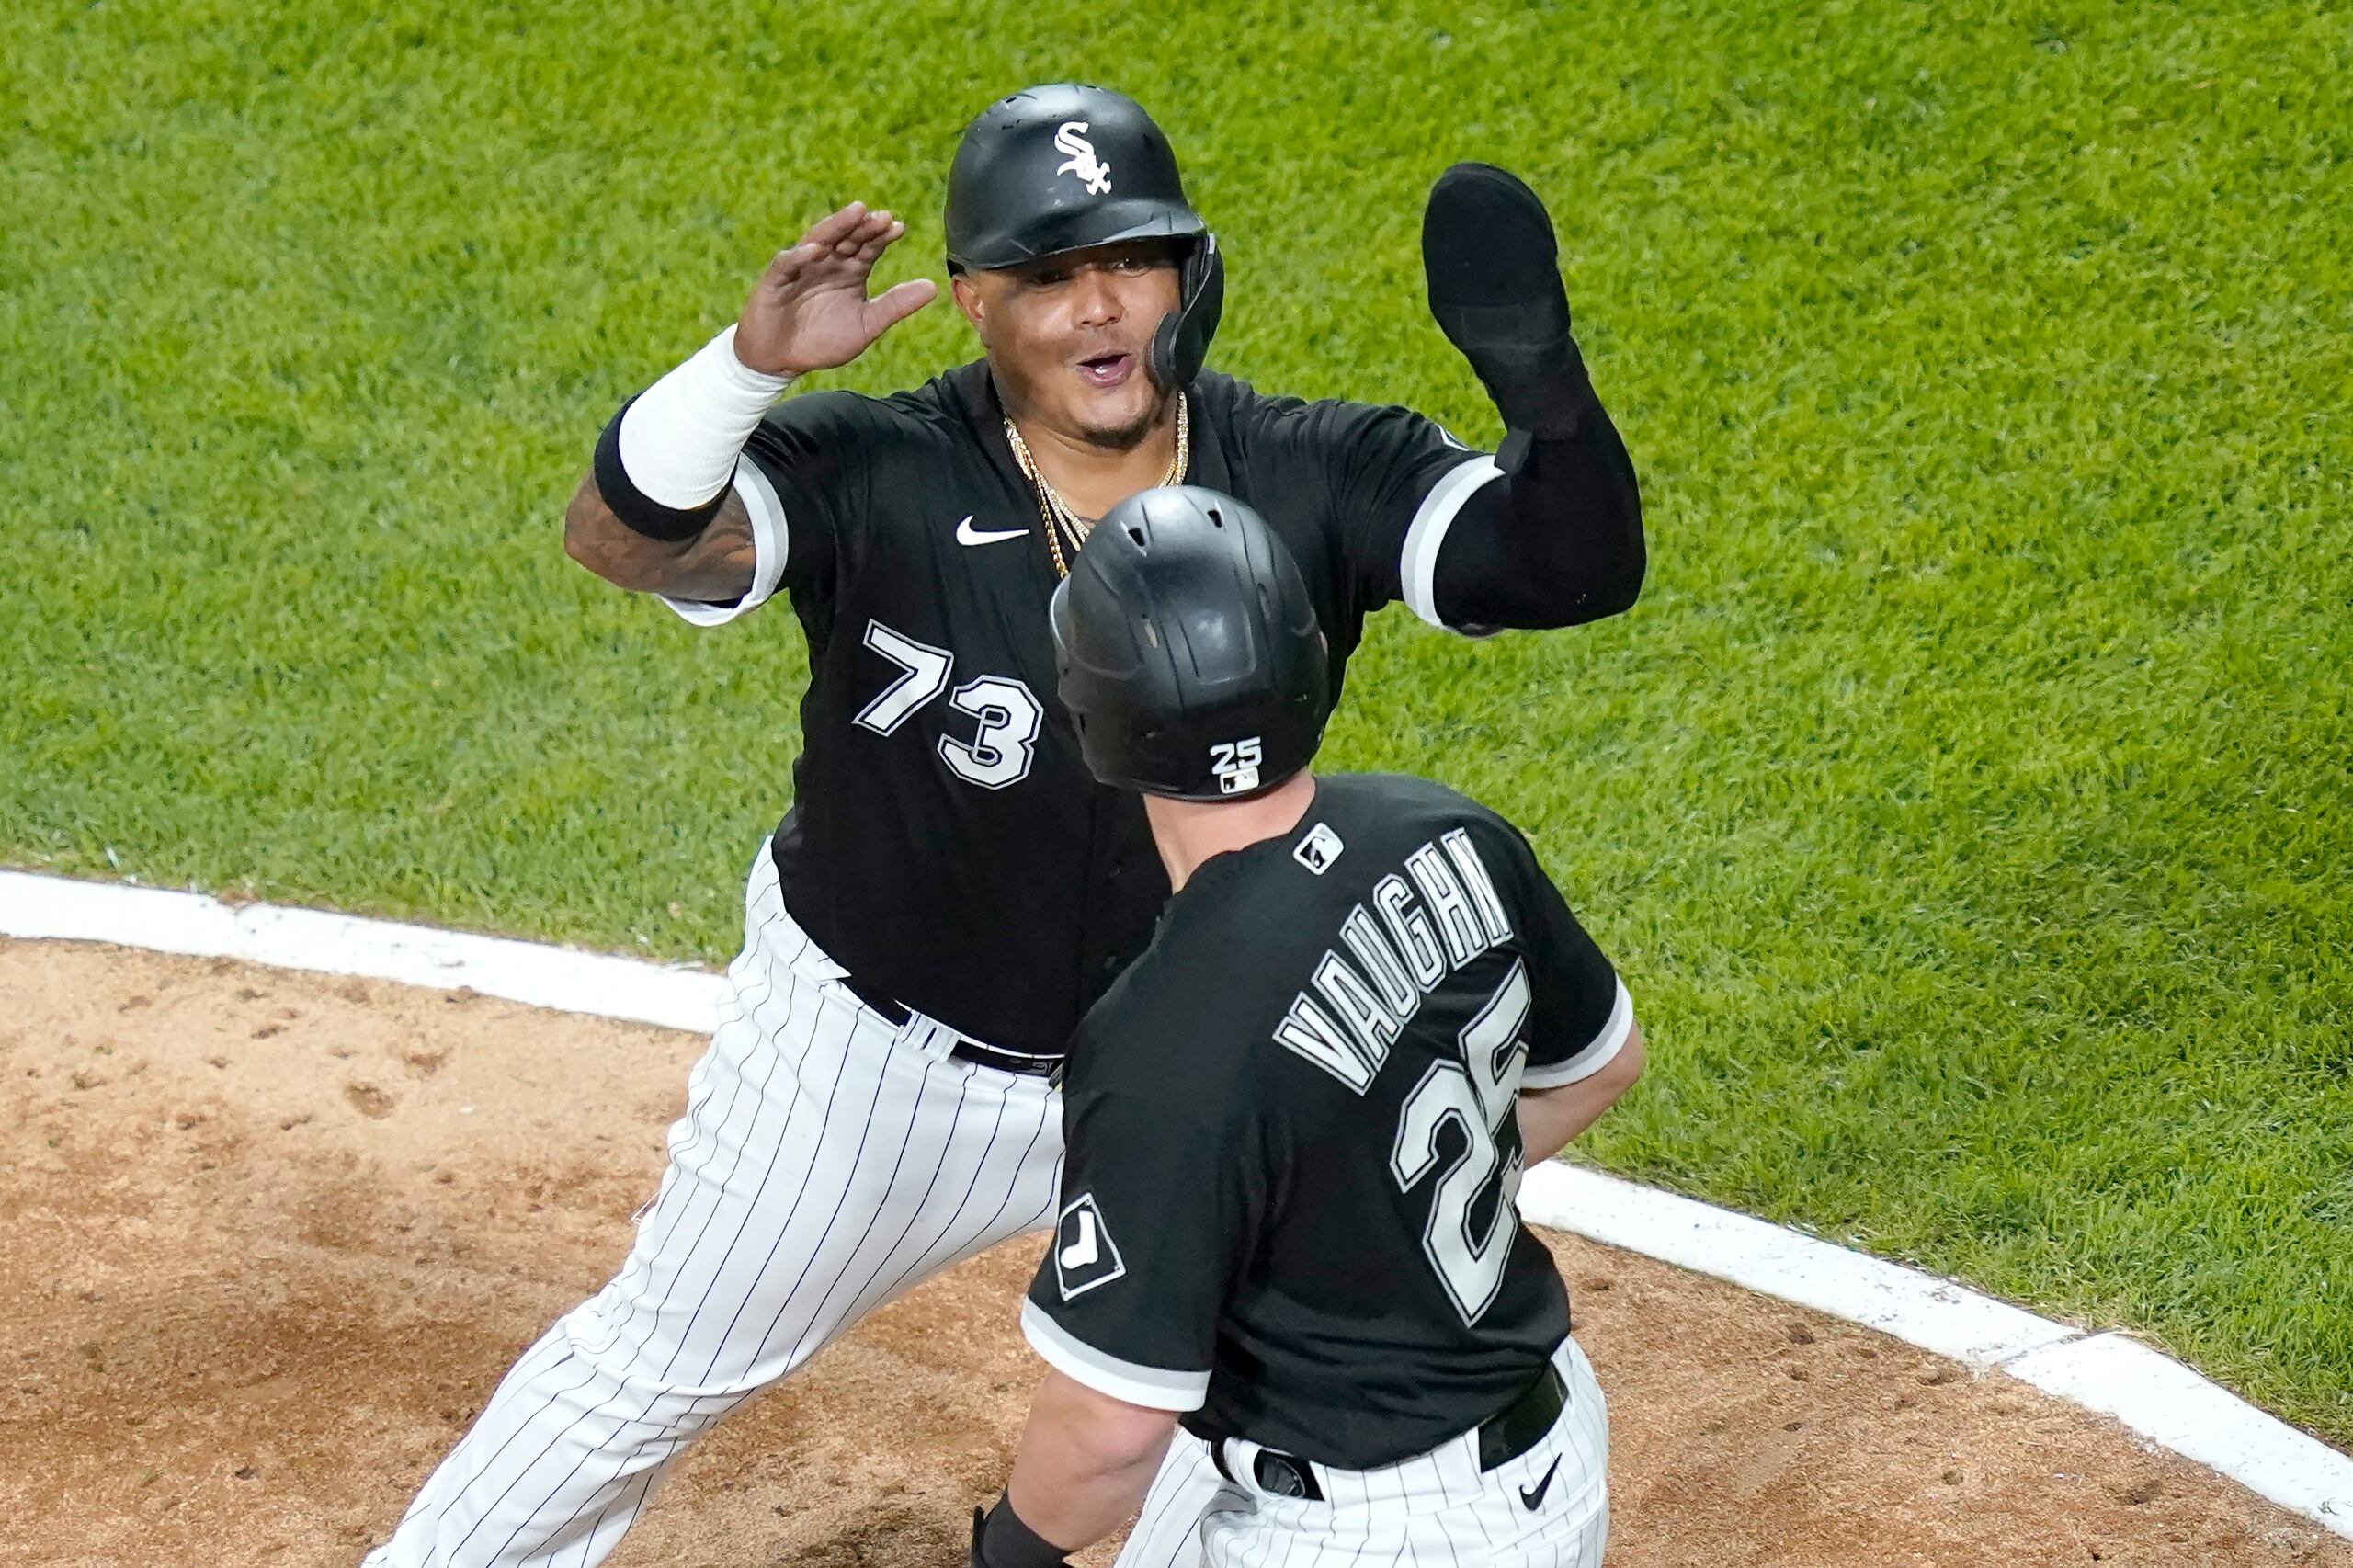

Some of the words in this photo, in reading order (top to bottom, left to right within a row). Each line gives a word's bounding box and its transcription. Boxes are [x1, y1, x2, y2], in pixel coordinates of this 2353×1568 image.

[1054, 121, 1112, 196] Sox
[851, 618, 1044, 790] 73
[1210, 736, 1262, 775] 25
[1272, 827, 1515, 1096] VAUGHN
[1390, 956, 1531, 1329] 25
